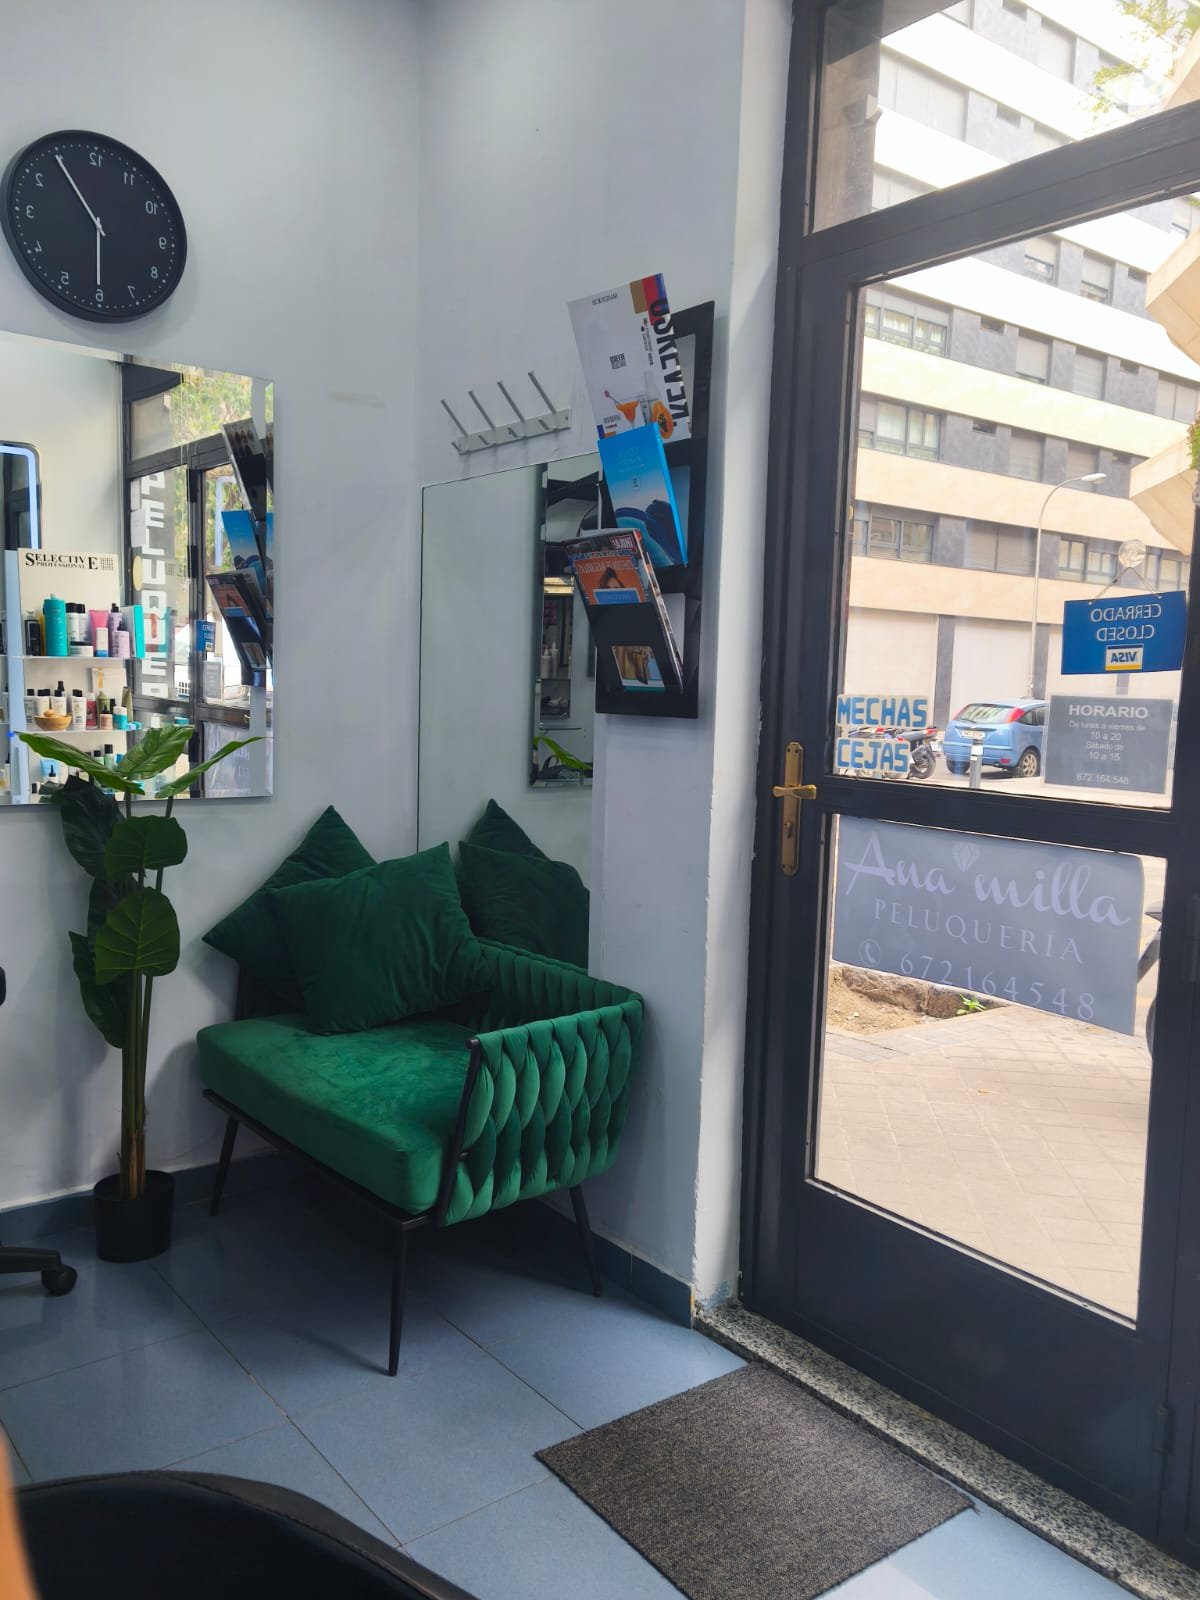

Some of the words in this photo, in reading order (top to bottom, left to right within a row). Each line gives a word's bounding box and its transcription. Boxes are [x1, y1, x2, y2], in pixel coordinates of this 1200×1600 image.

[25, 552, 98, 570] SELECTIVE
[837, 696, 928, 728] MECHAS
[1068, 703, 1149, 720] HORARIO
[1091, 731, 1101, 740] 10
[1102, 733, 1109, 741] a
[1110, 732, 1122, 741] 20
[837, 738, 909, 773] CEJAS
[1089, 751, 1099, 760] 10
[1101, 753, 1107, 761] a
[1110, 752, 1120, 761] 15
[1114, 743, 1125, 752] de
[843, 832, 955, 896] Ana
[974, 862, 1132, 926] milla
[875, 897, 1084, 964] PELUQUERÍA
